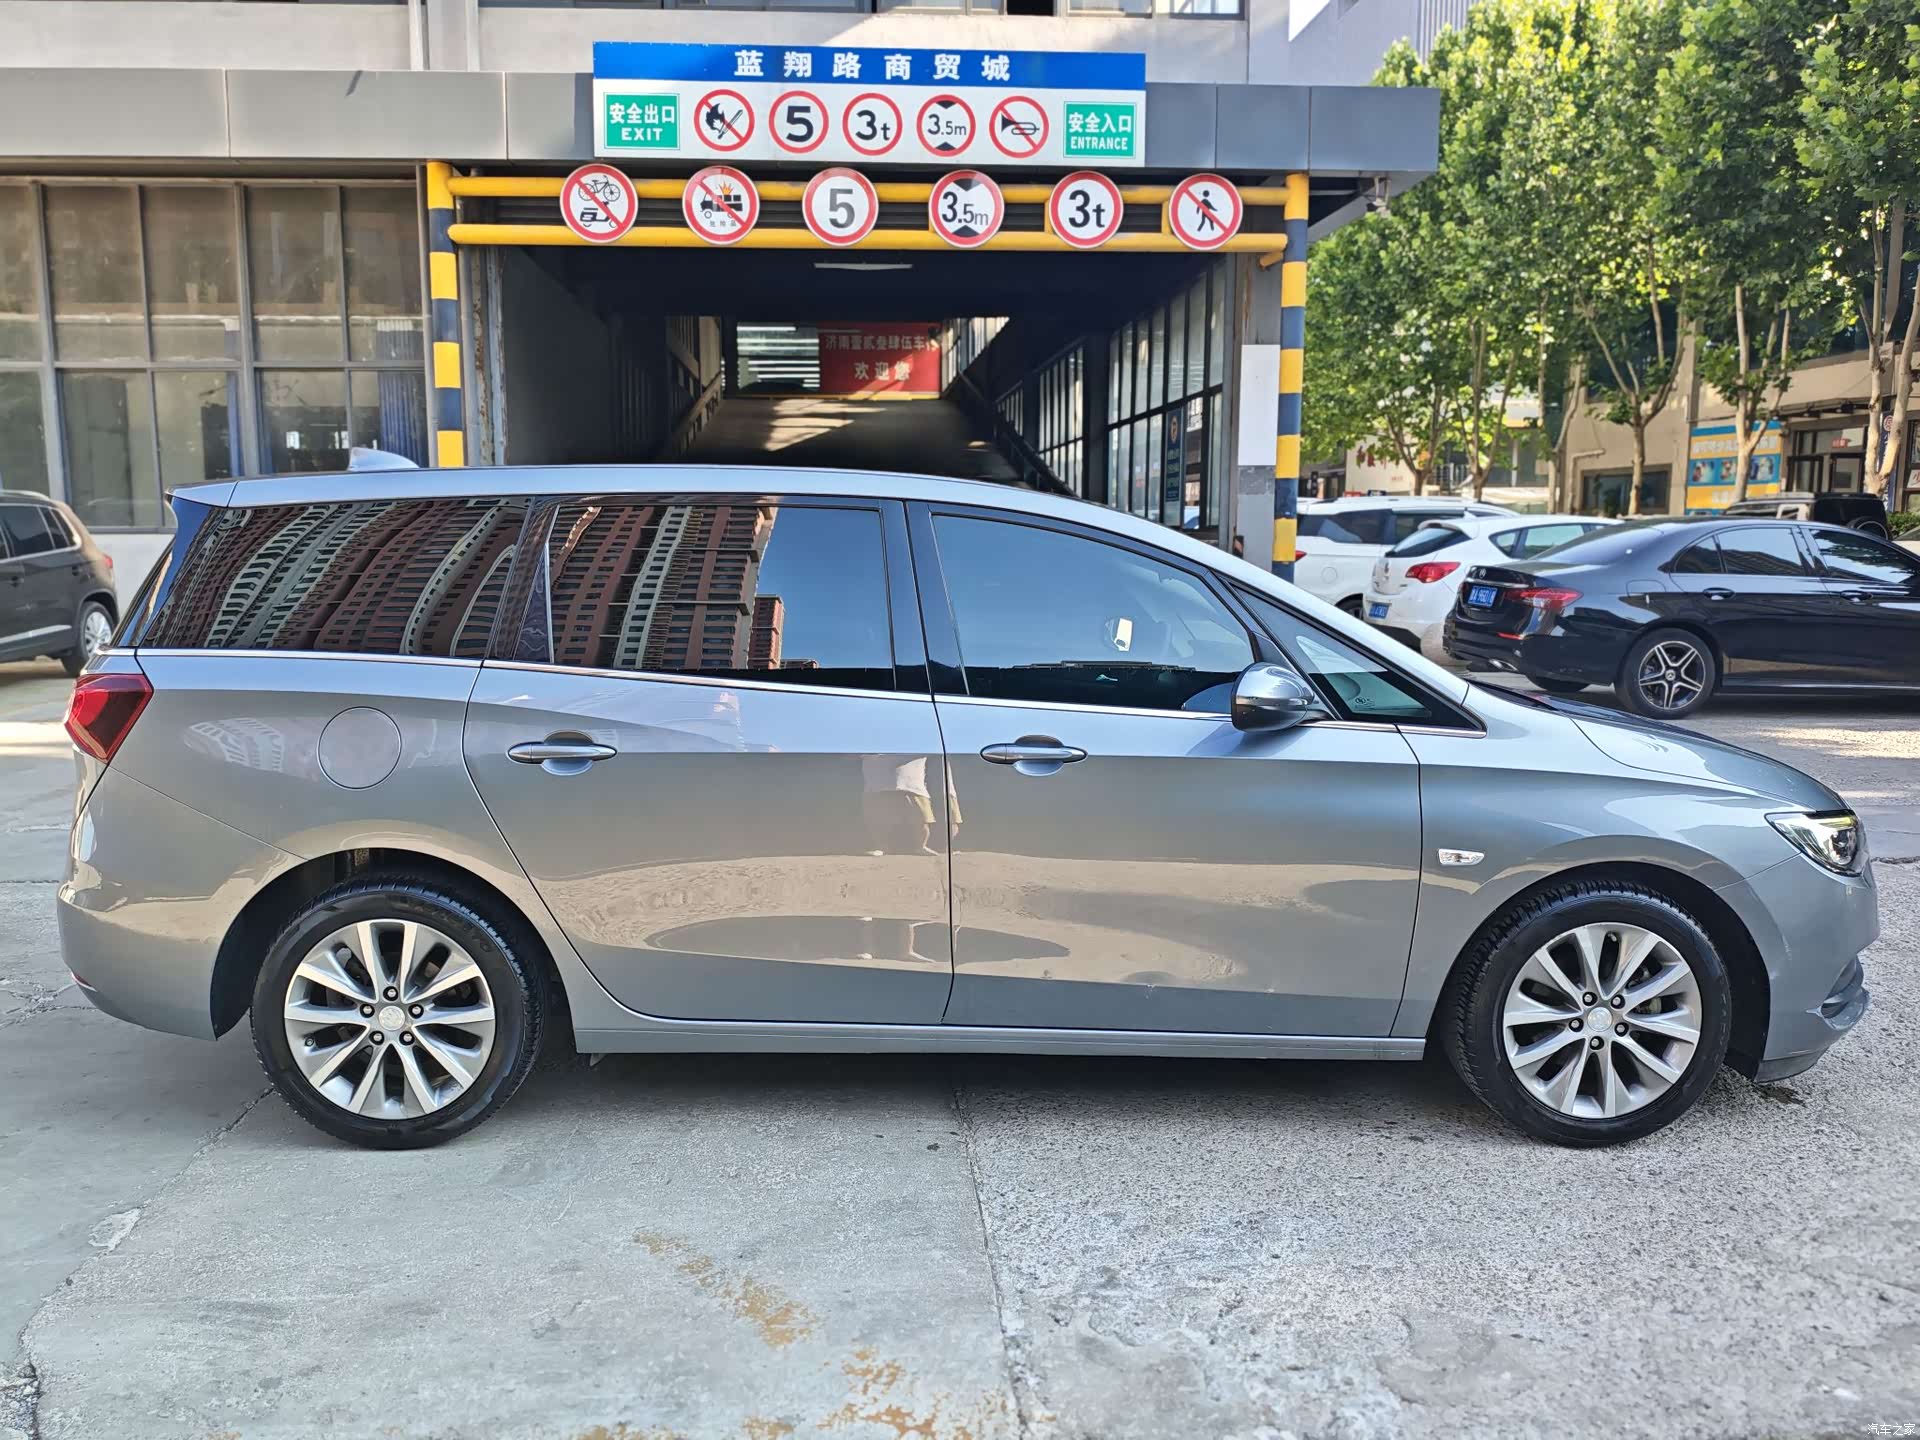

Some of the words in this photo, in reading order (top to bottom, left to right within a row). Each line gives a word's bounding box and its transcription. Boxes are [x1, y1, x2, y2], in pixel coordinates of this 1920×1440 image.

[734, 50, 1011, 80] 蓝翔路商贸城
[609, 103, 675, 125] 安全出口
[785, 105, 815, 143] 5
[855, 110, 891, 141] 3t
[927, 114, 967, 136] 3.5m
[1068, 113, 1132, 134] 安全入口
[621, 128, 664, 142] EXIT
[1071, 136, 1128, 150] ENTRANCE
[828, 188, 856, 229] 5
[941, 191, 989, 225] 3.5m
[1068, 190, 1106, 228] 3t
[854, 361, 910, 380] 欢迎您
